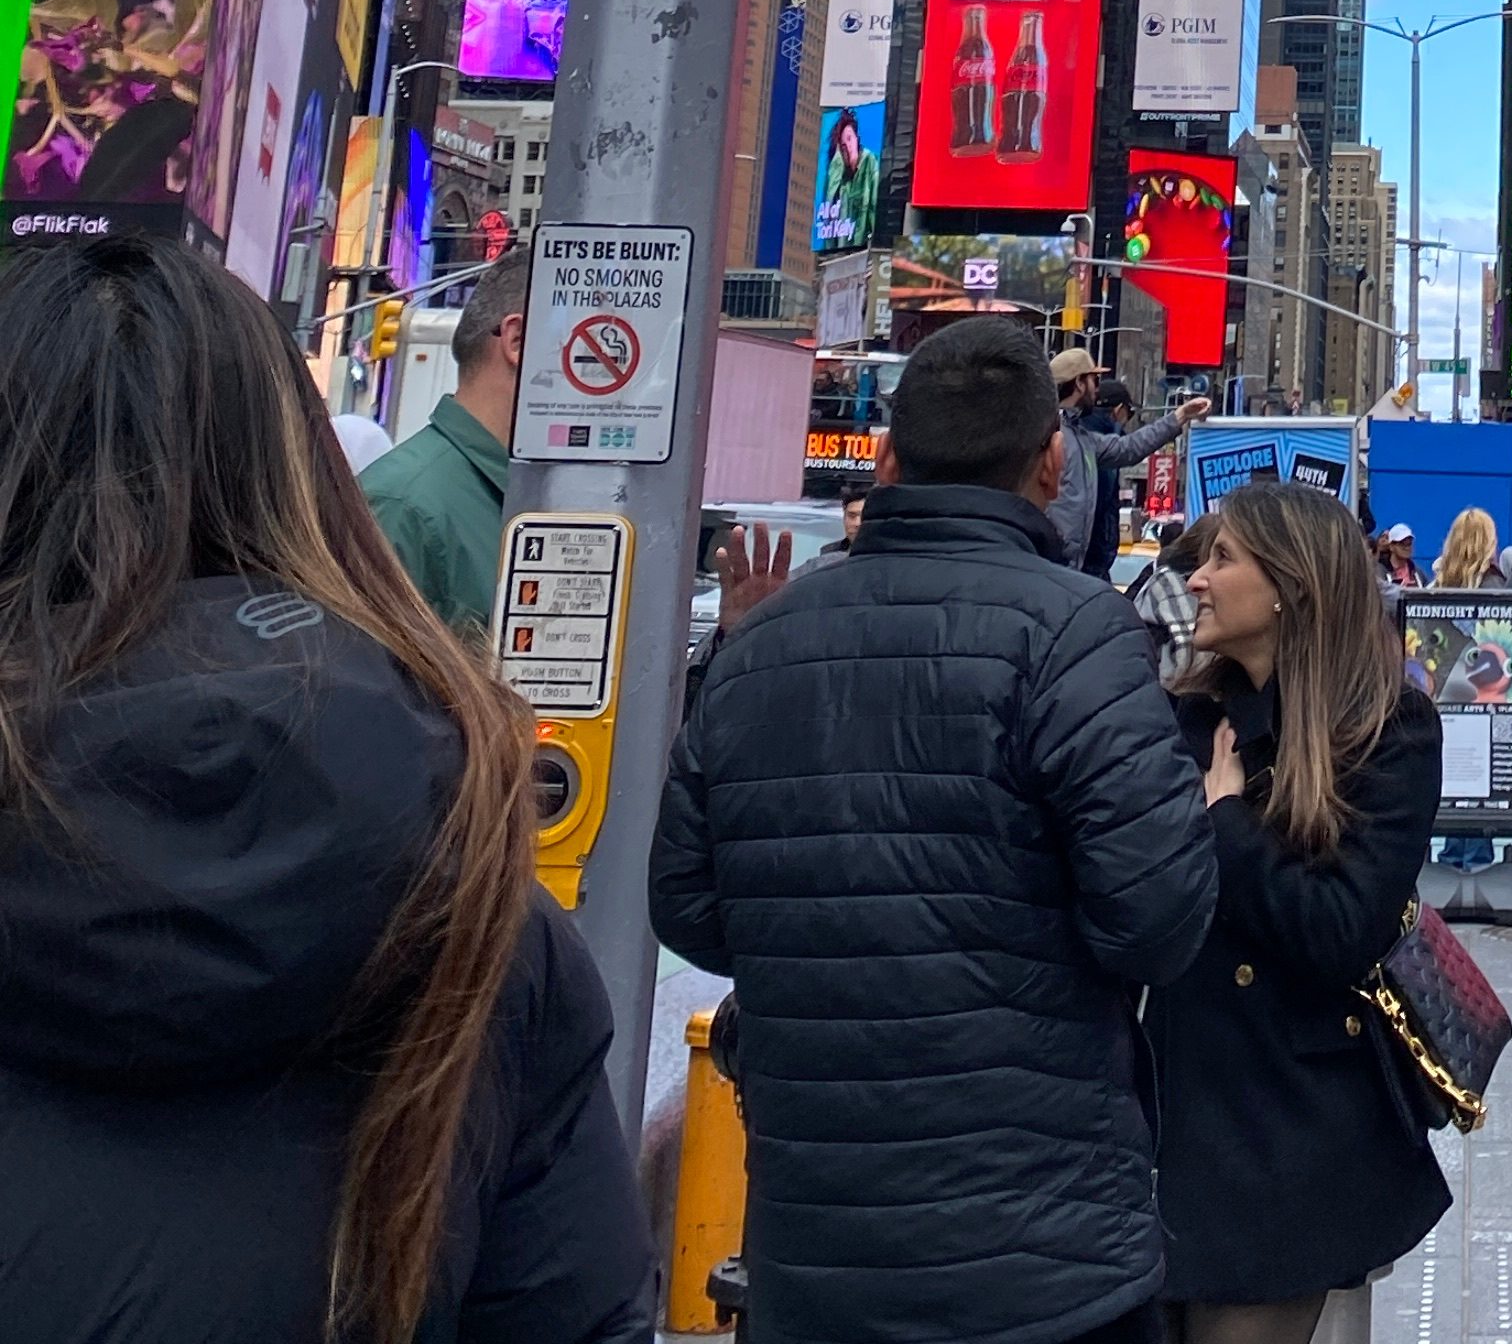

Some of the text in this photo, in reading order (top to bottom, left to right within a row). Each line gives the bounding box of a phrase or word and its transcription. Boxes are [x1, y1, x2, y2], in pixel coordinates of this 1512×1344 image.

[1171, 18, 1217, 34] PGIM
[12, 215, 109, 236] @FlikFlak
[543, 240, 681, 262] LET'S BE BLUNT:
[555, 268, 663, 288] NO SMOKING
[963, 262, 998, 286] DC
[552, 290, 568, 307] IN
[807, 433, 877, 459] BUS TOU
[1202, 448, 1274, 477] EXPLORE
[1405, 605, 1474, 618] MIDNIGHT
